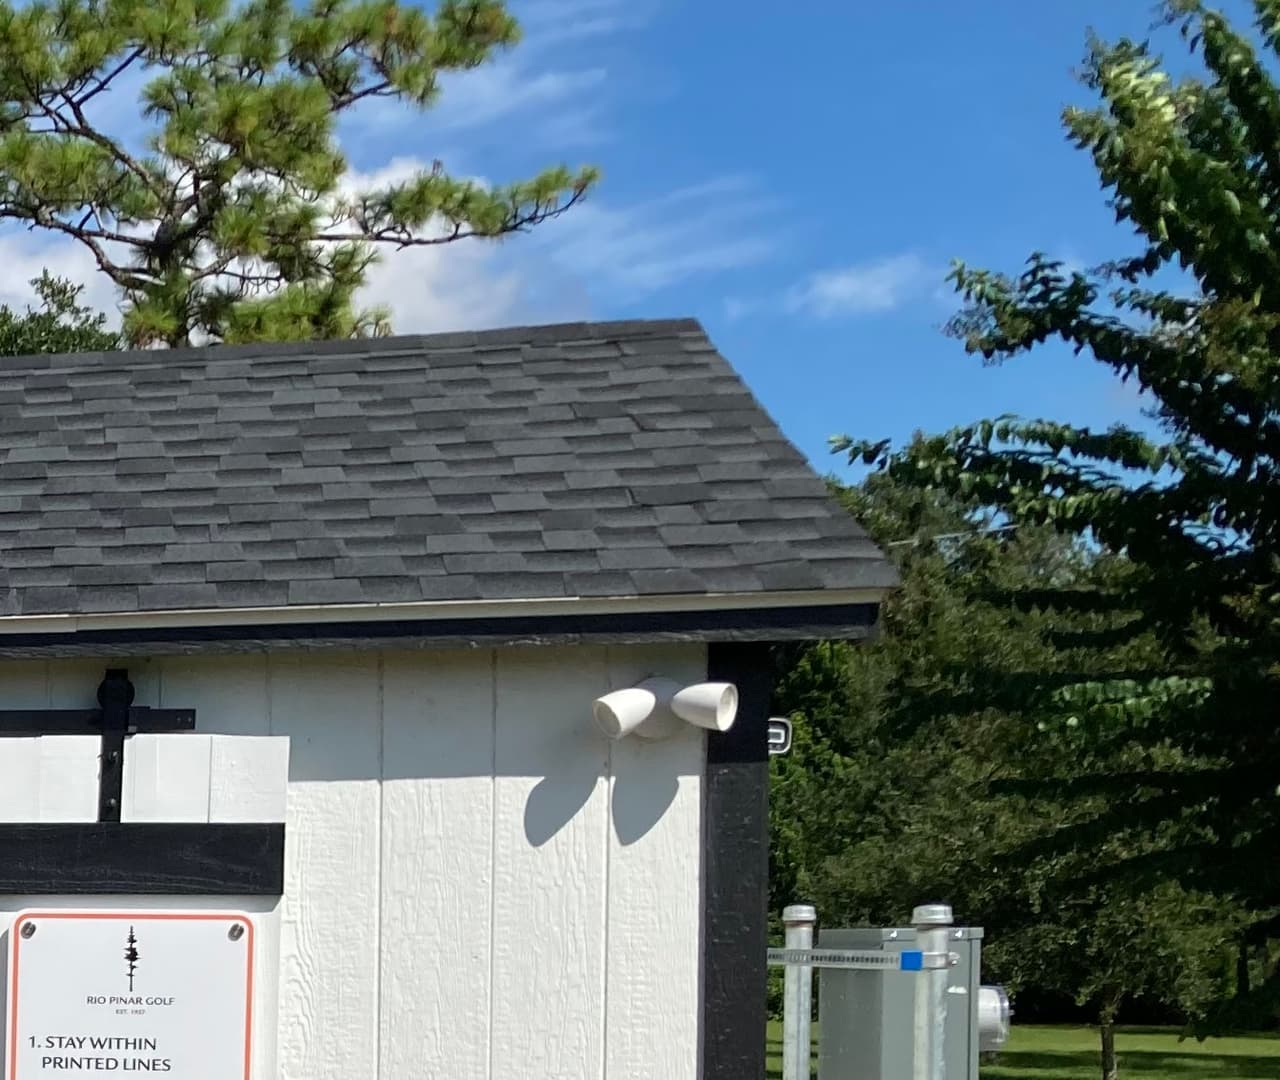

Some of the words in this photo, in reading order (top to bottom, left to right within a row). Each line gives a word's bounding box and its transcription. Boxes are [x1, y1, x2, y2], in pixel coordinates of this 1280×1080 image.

[86, 996, 106, 1005] RIO
[109, 996, 143, 1005] PINAR
[146, 997, 176, 1006] GOLF
[29, 1036, 41, 1049] 1.
[45, 1036, 87, 1050] STAY
[90, 1036, 157, 1051] WITHIN
[41, 1056, 119, 1071] PRINTED
[123, 1058, 171, 1072] LINES
